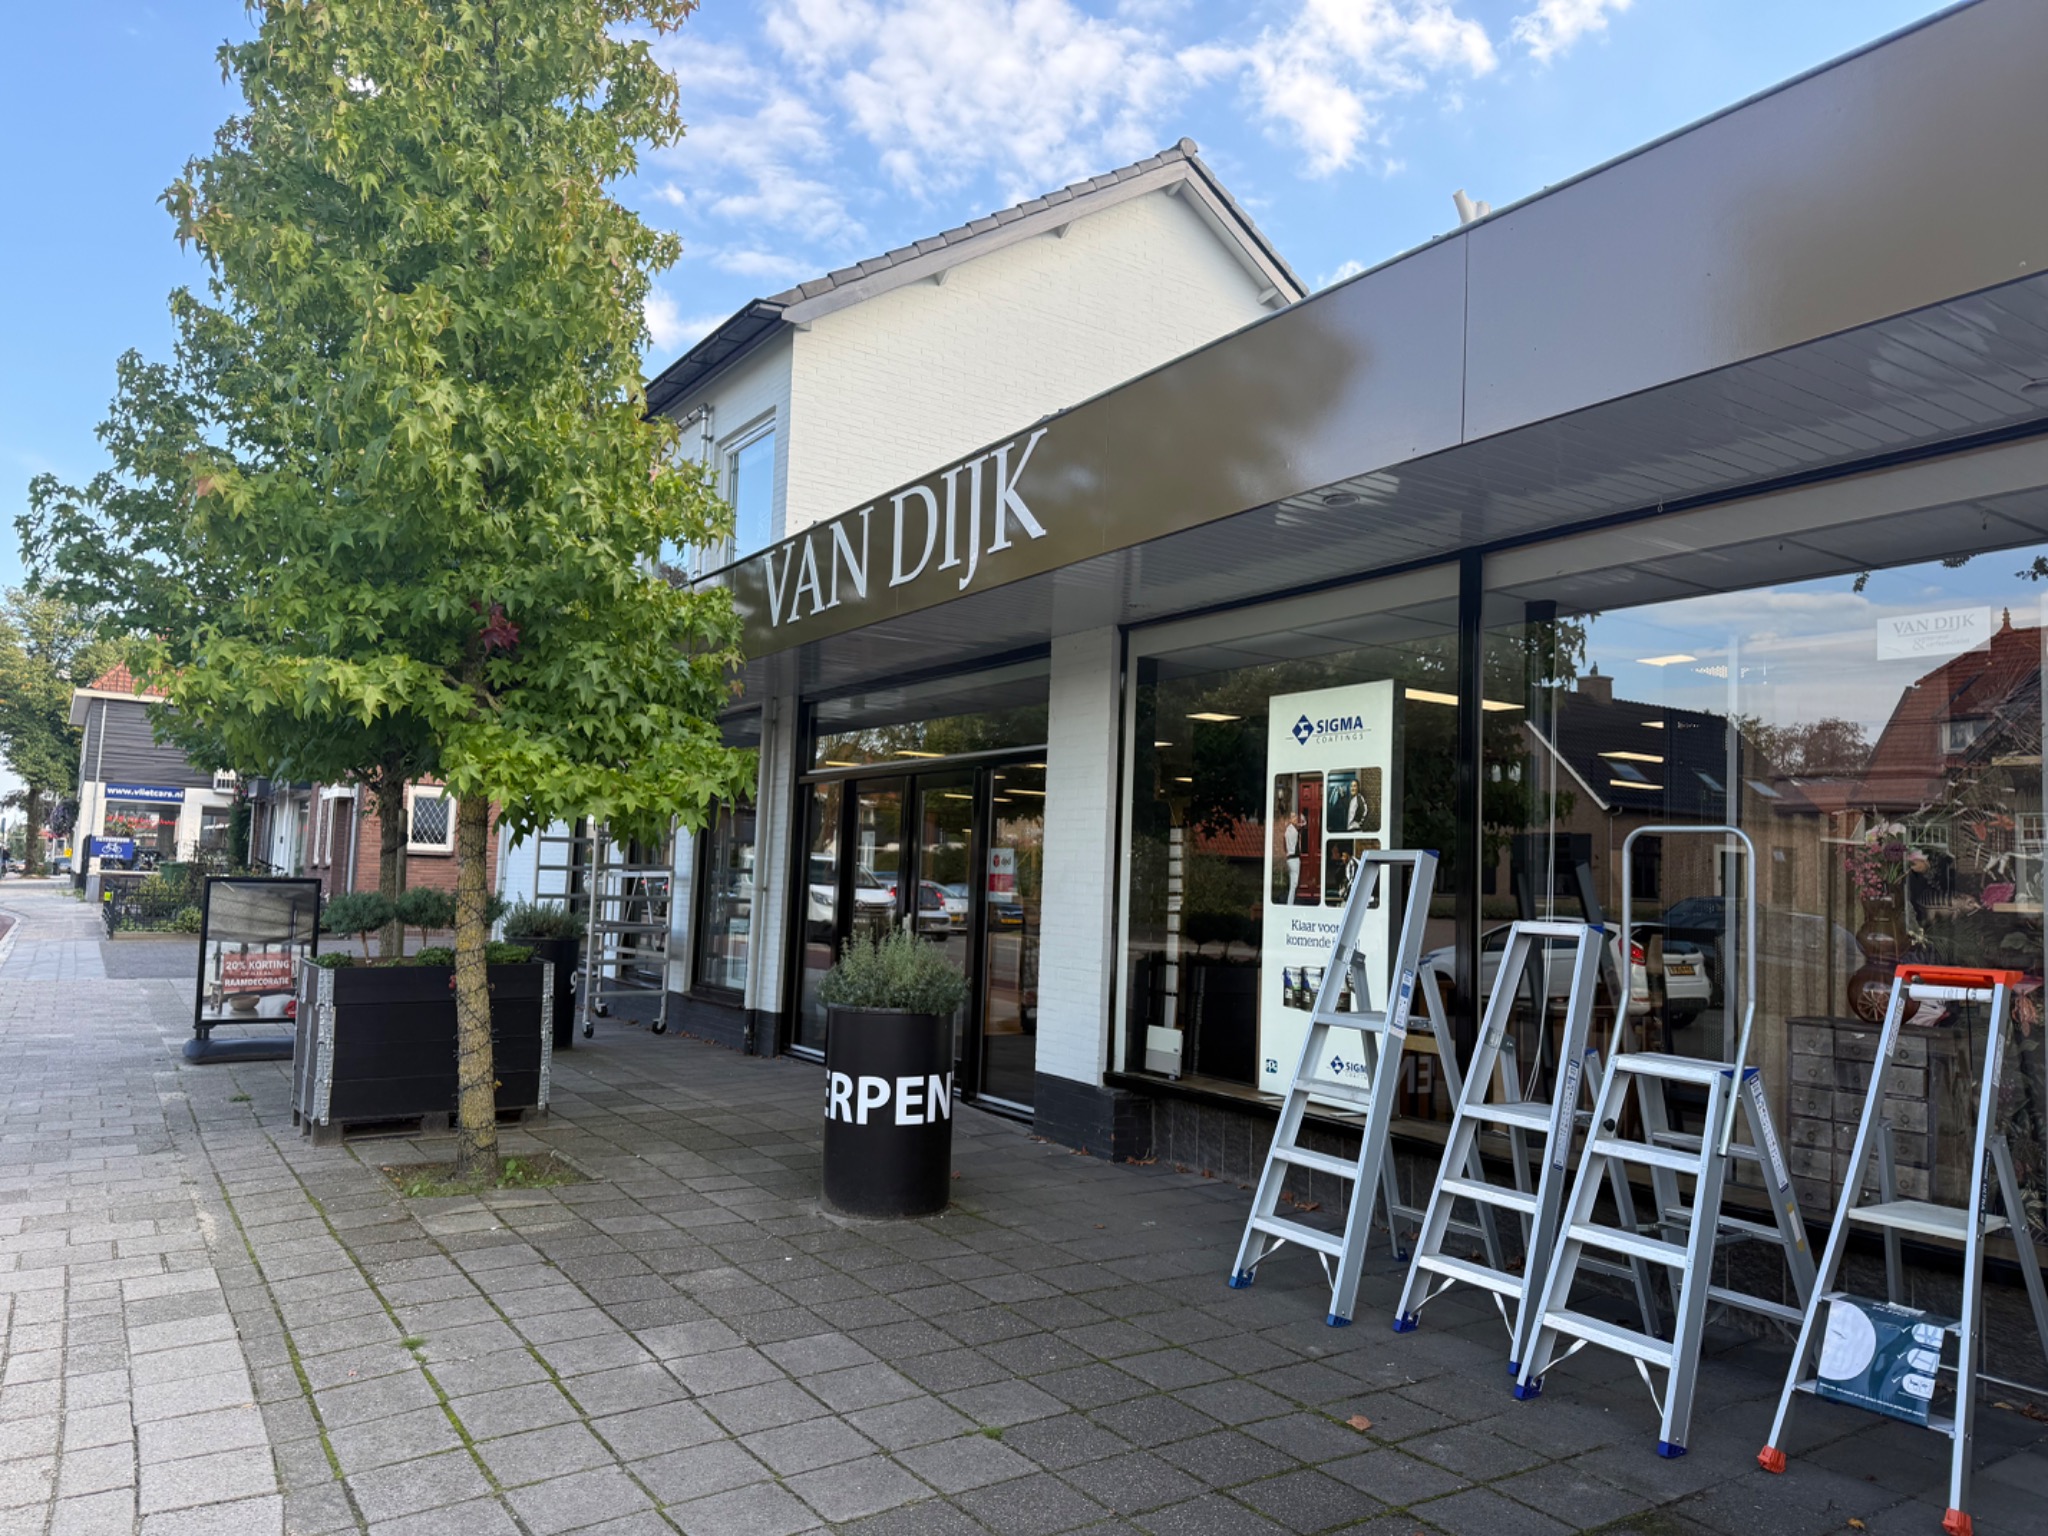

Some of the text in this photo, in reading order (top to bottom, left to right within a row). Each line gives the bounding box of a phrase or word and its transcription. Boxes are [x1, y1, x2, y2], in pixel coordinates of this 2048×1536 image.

[762, 427, 1048, 628] VAN DIJK
[1893, 614, 1974, 633] VAN DIJK
[1316, 715, 1364, 734] SIGMA
[1316, 732, 1364, 744] COATINGS
[1291, 919, 1340, 934] Klaar voor
[1286, 934, 1331, 948] komende
[226, 959, 290, 971] 20% KORTING
[224, 976, 290, 987] RAAMDECORATIE
[1345, 1062, 1368, 1074] SIGM
